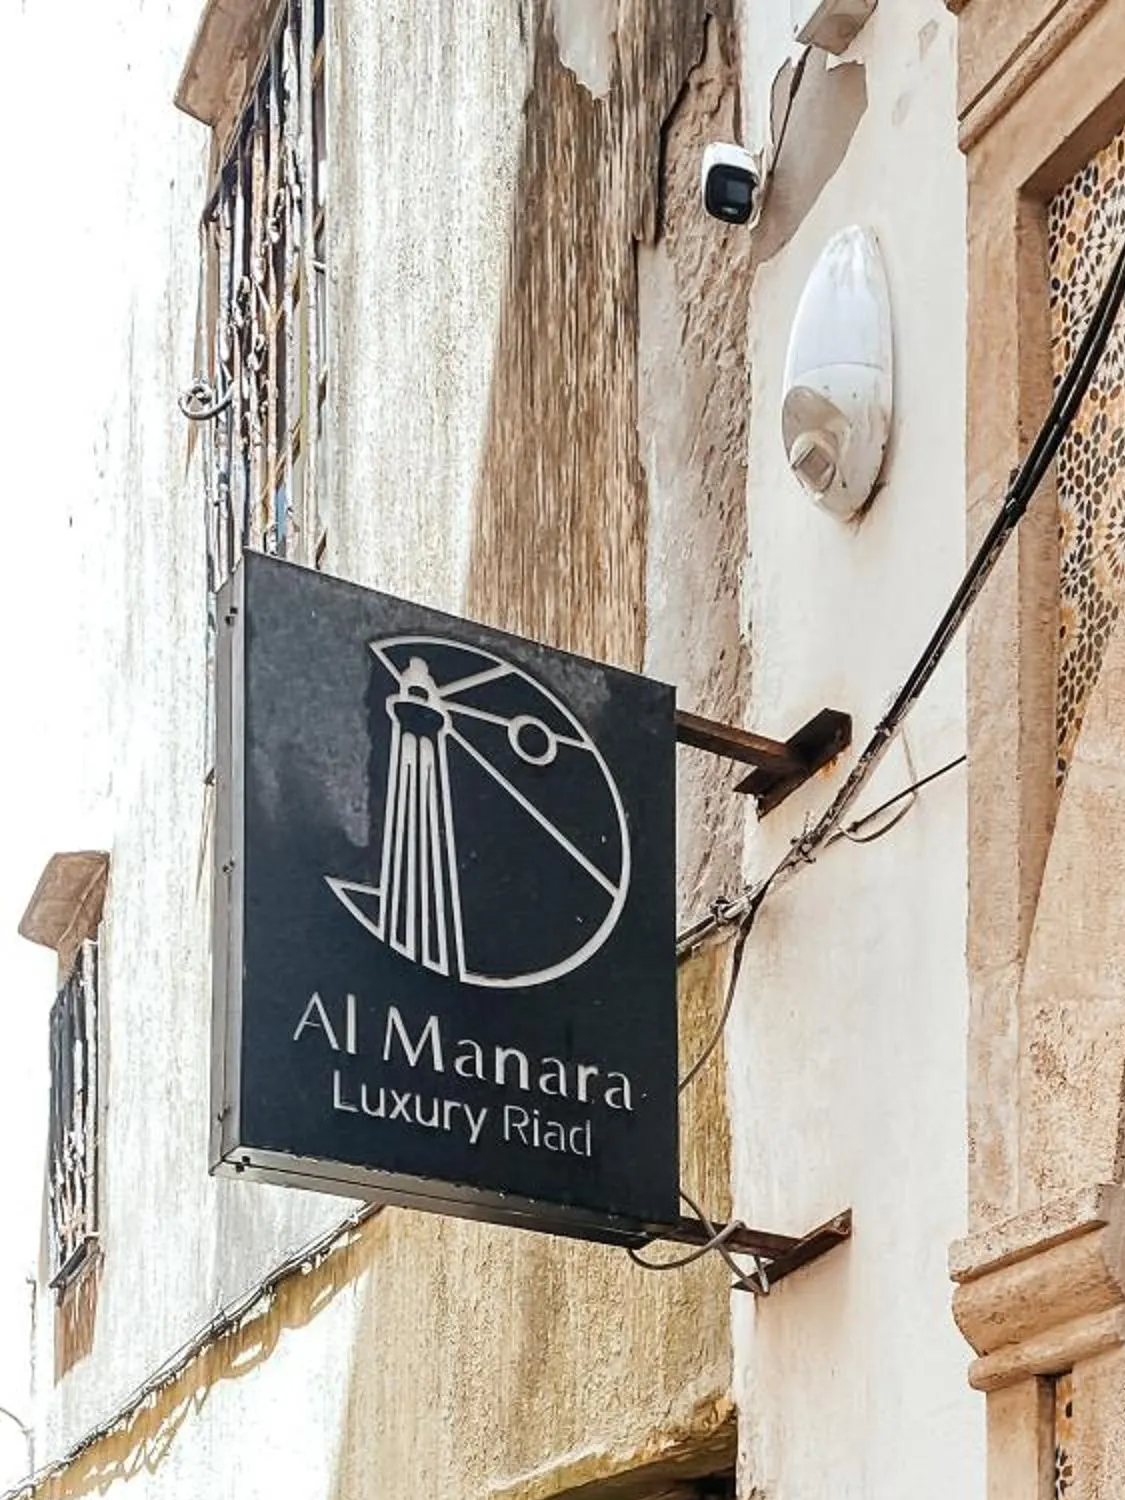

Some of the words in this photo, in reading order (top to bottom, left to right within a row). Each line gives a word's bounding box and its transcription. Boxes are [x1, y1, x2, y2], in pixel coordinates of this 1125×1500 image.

[293, 991, 357, 1055] Al
[383, 1006, 634, 1112] Manara
[333, 1069, 488, 1144] Luxury
[503, 1104, 592, 1157] Riad
